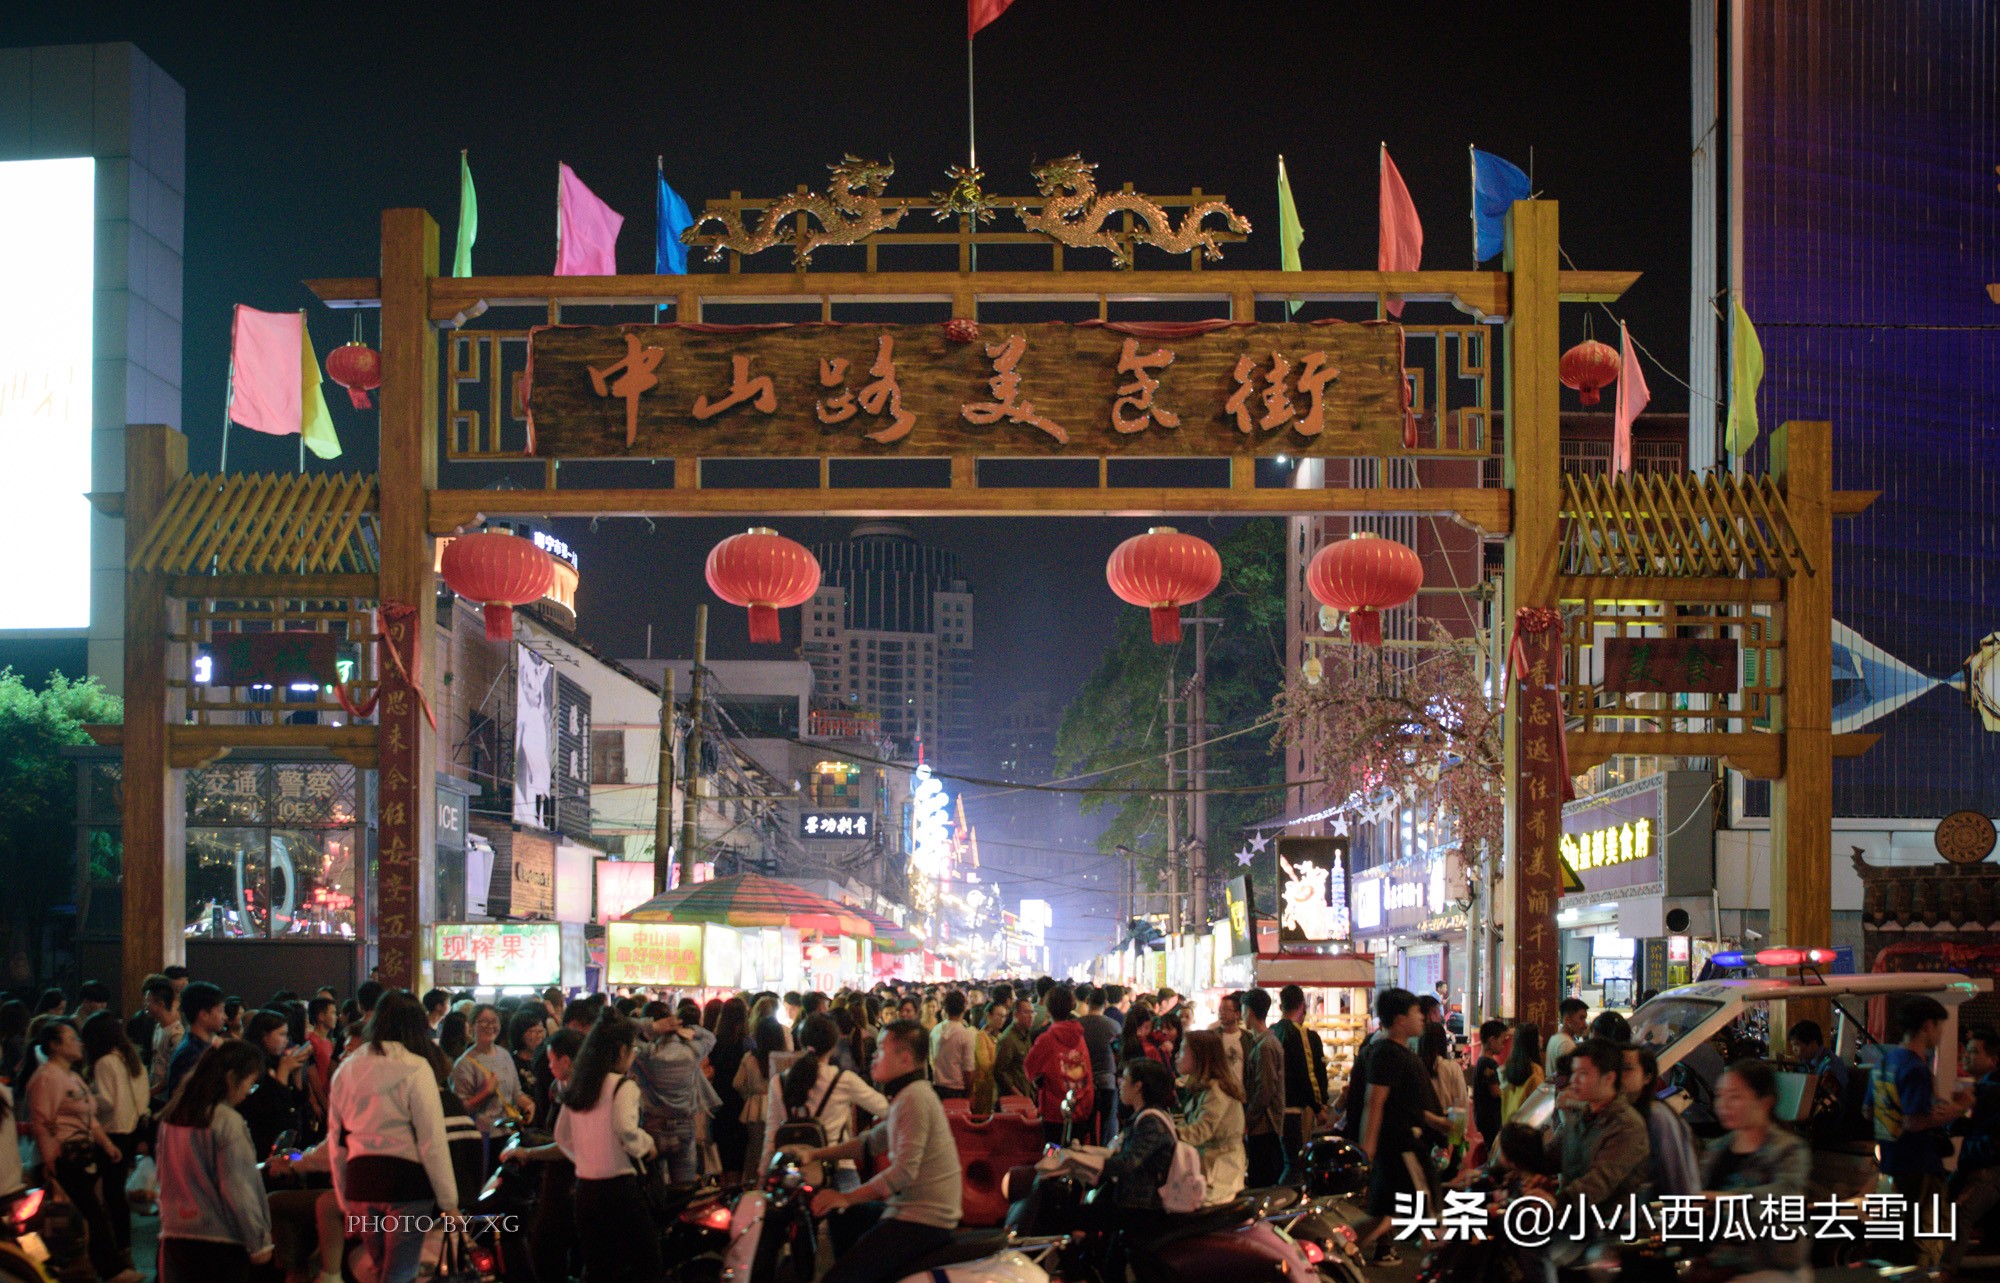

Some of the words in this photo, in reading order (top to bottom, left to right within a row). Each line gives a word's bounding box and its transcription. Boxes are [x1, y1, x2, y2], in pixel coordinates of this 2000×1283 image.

[587, 332, 1342, 449] 中山路美食街
[204, 769, 258, 797] 交通
[277, 769, 333, 799] 警察
[442, 933, 548, 961] 现榨果汁
